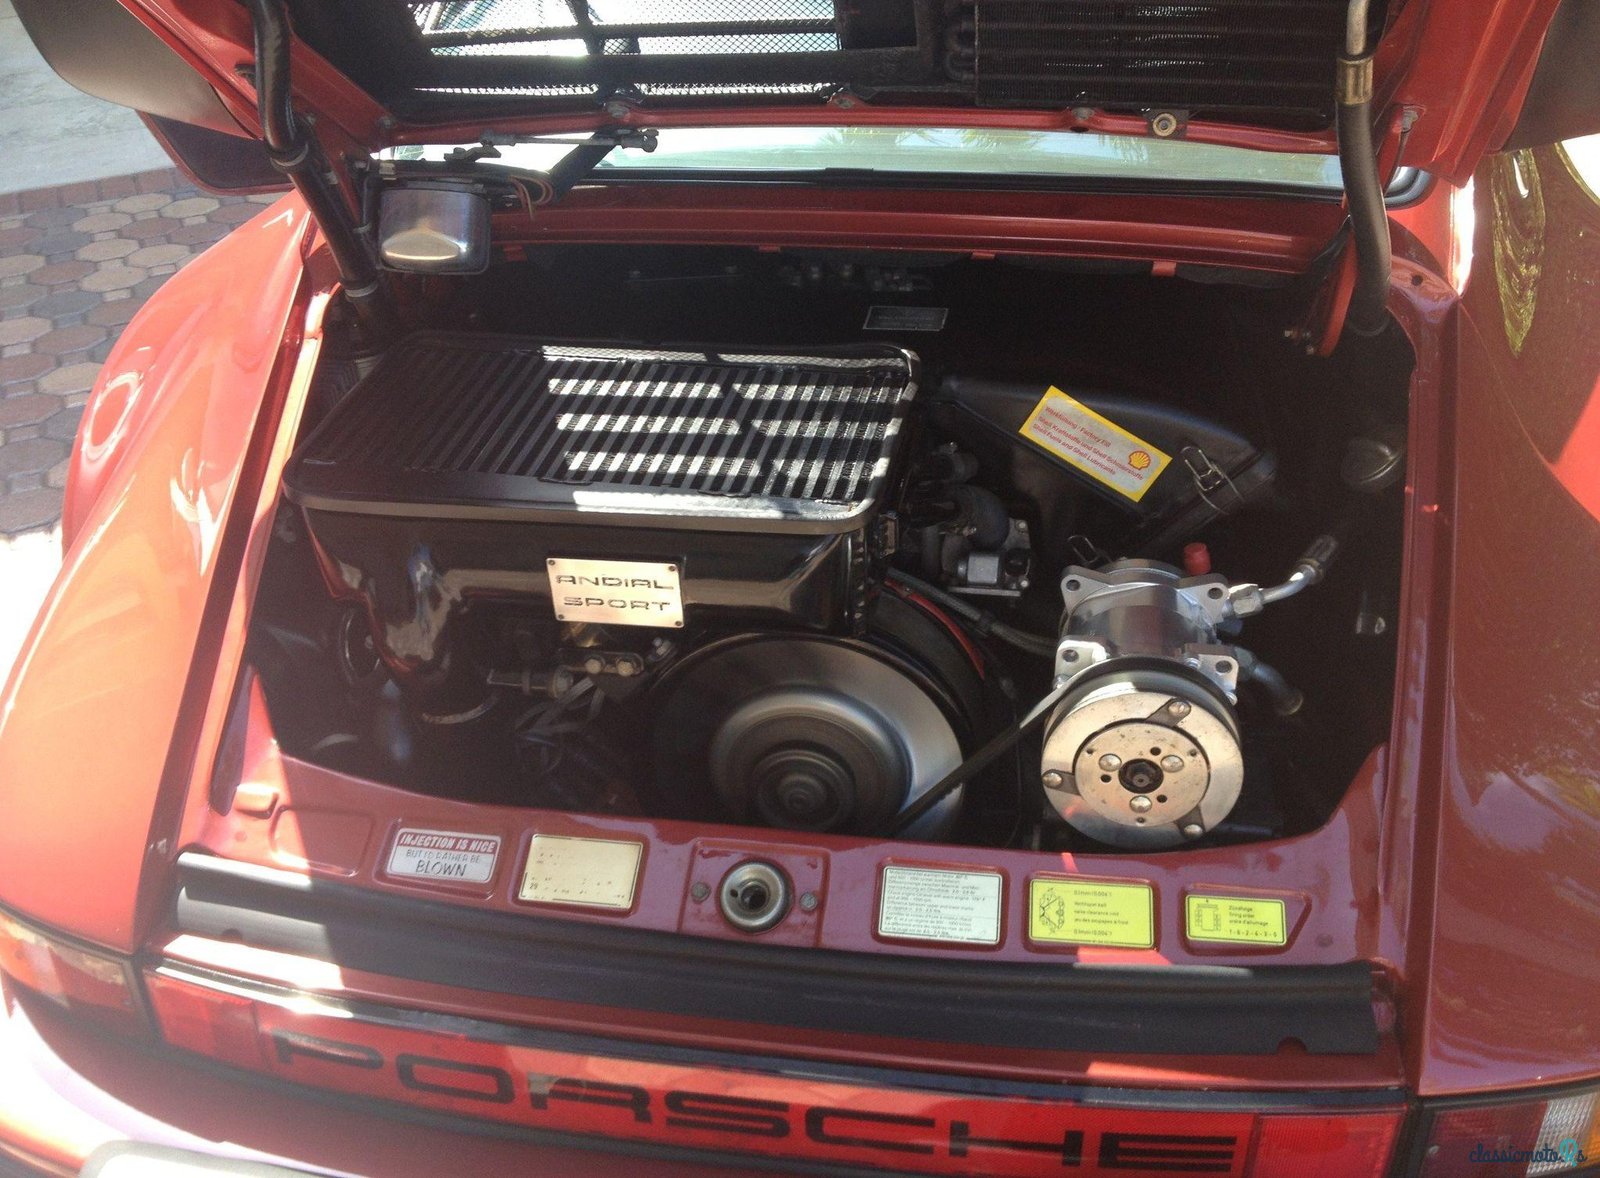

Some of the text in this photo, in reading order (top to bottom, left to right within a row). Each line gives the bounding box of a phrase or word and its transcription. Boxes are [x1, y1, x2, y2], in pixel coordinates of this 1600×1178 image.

[1080, 427, 1101, 443] Factory
[1061, 440, 1073, 450] and
[1073, 446, 1088, 459] Shell
[1087, 455, 1116, 476] Lubricants
[1081, 441, 1092, 451] und
[1093, 446, 1107, 459] Shell
[556, 575, 674, 590] ANDIAL
[564, 596, 670, 611] SPORT
[400, 833, 496, 853] INJECTION IS NICE
[406, 849, 421, 858] BUT
[436, 851, 468, 862] RATHER
[470, 854, 480, 863] BE
[416, 859, 467, 877] BLOWN
[272, 1028, 1237, 1172] PORSCHE
